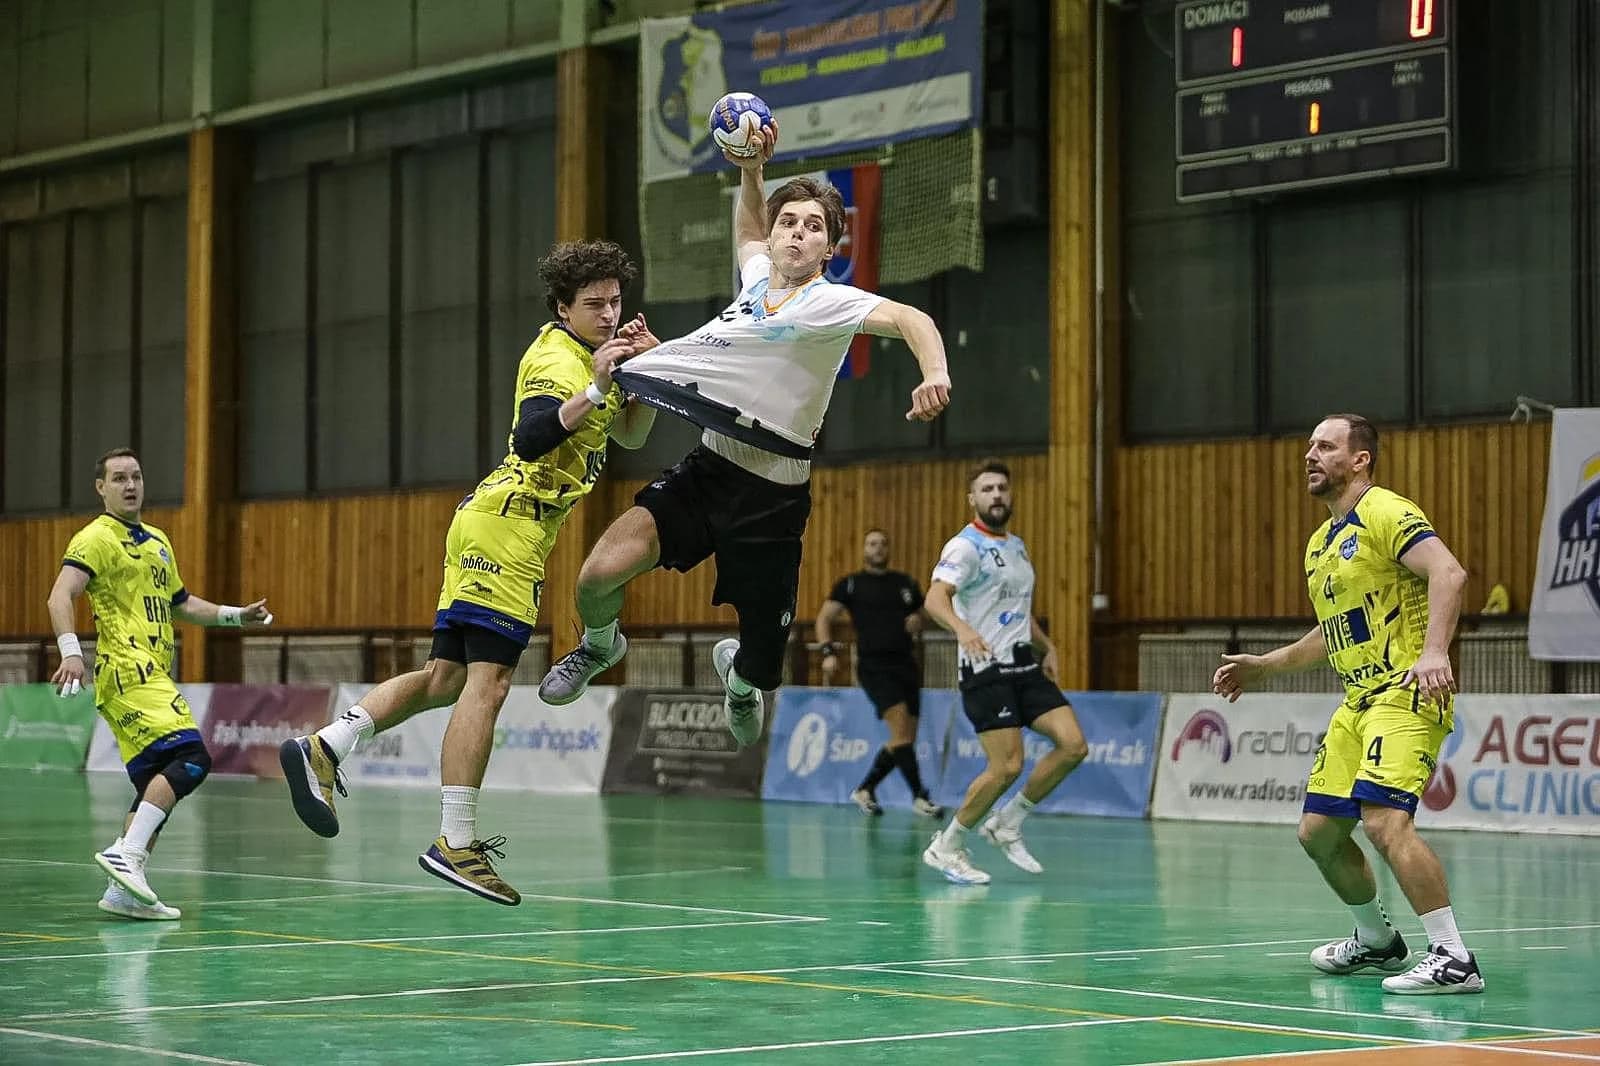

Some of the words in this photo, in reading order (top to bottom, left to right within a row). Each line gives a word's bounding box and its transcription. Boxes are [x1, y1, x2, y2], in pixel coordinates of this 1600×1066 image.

[1232, 26, 1243, 67] 1
[1309, 101, 1320, 134] 1
[151, 565, 168, 590] 84
[1323, 574, 1336, 605] 4
[1366, 736, 1383, 767] 4
